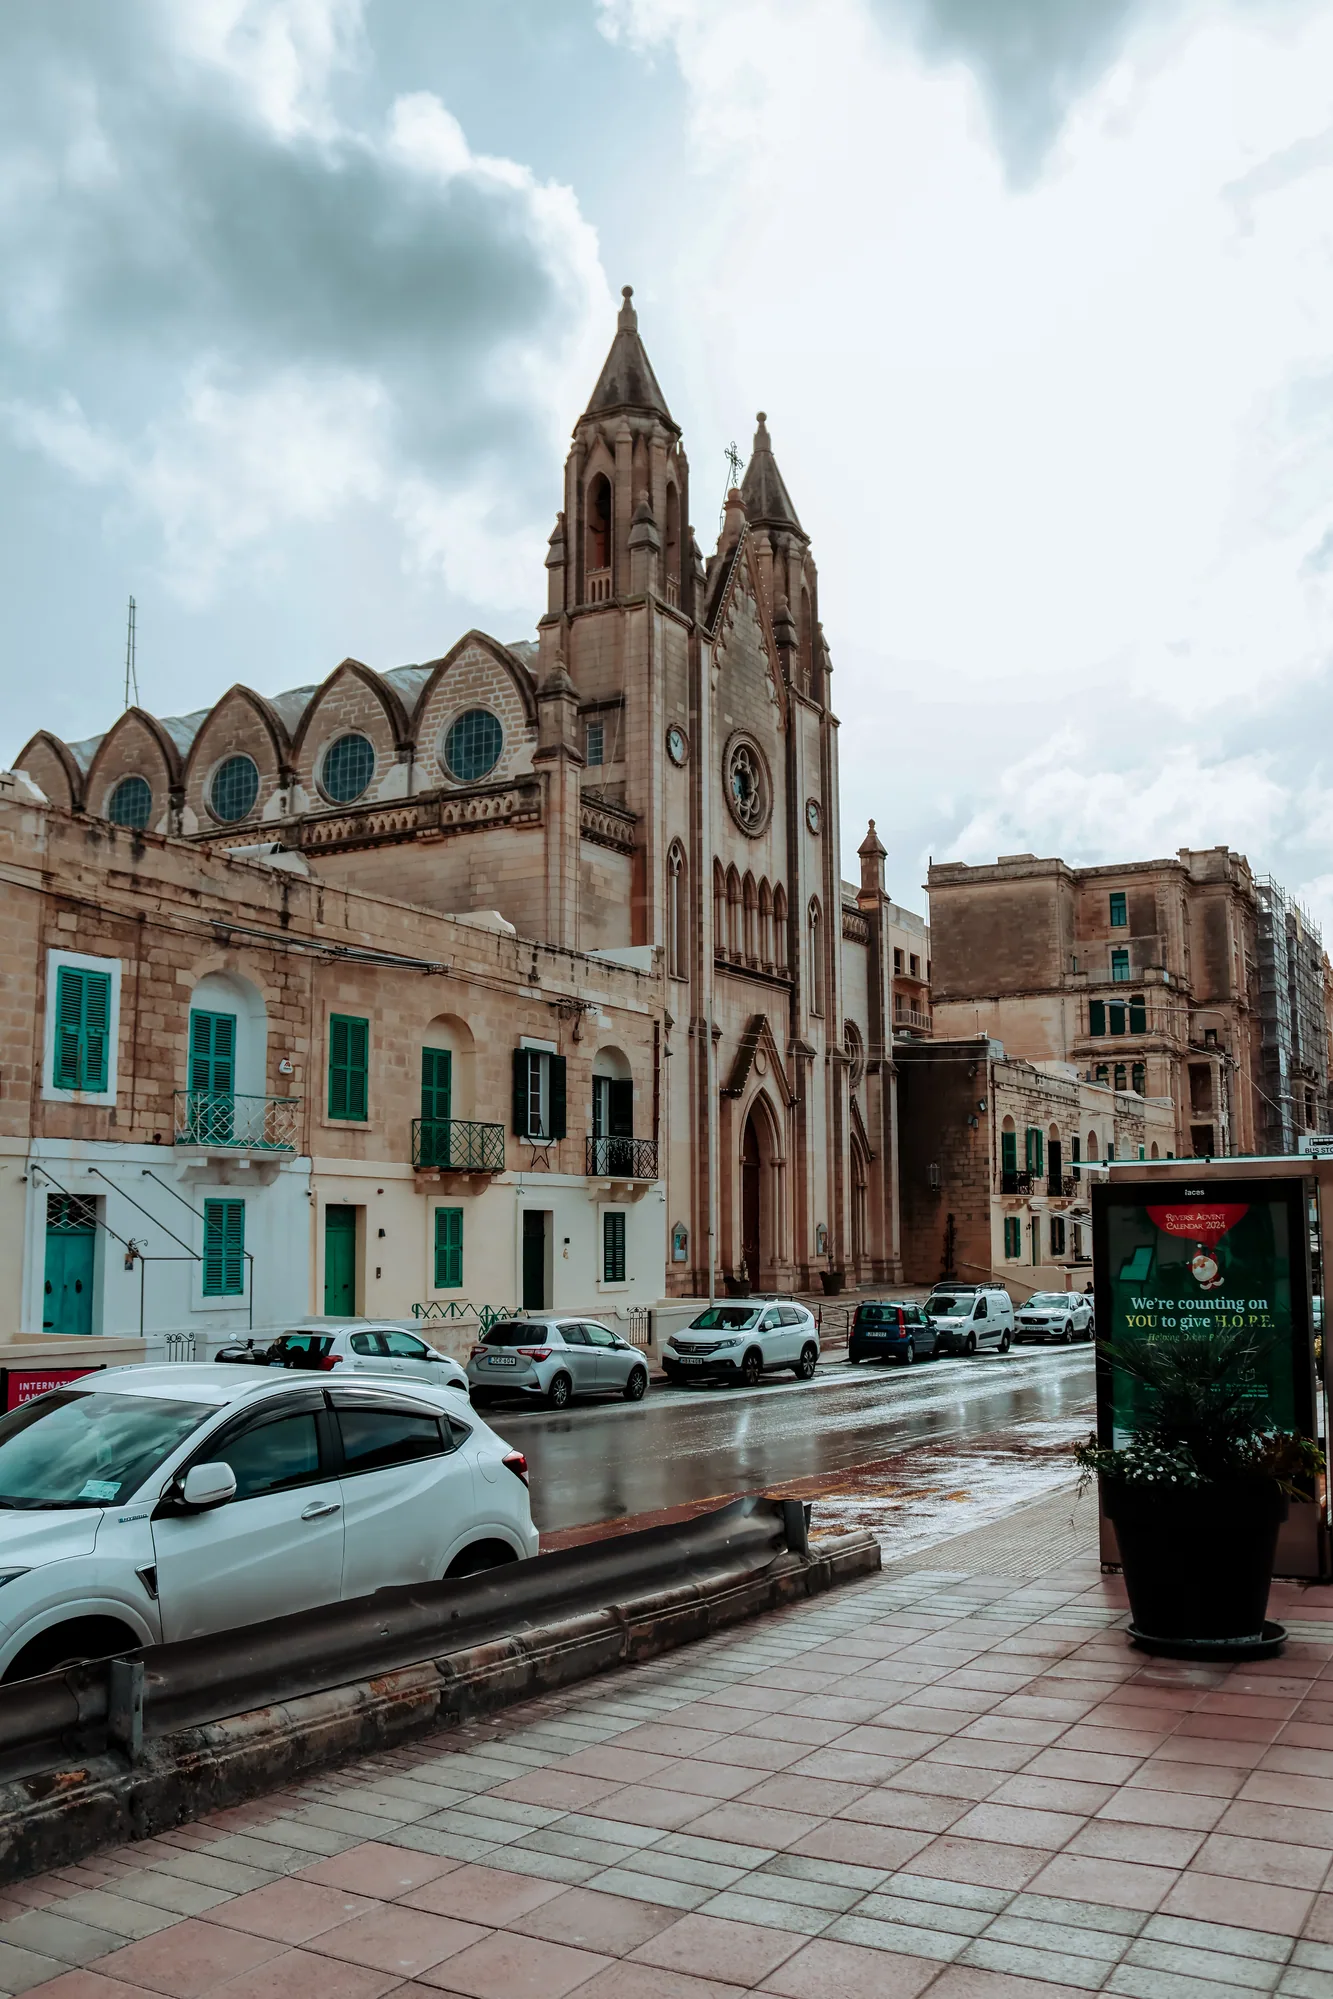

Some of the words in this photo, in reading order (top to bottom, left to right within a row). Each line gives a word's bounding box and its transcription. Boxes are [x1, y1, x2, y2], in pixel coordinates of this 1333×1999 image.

[1206, 1221, 1226, 1229] 2024
[1131, 1297, 1174, 1310] We're
[1178, 1296, 1245, 1313] counting
[1248, 1299, 1268, 1310] on
[1126, 1315, 1158, 1328] YOU
[1161, 1316, 1177, 1328] to
[1180, 1315, 1211, 1332] give
